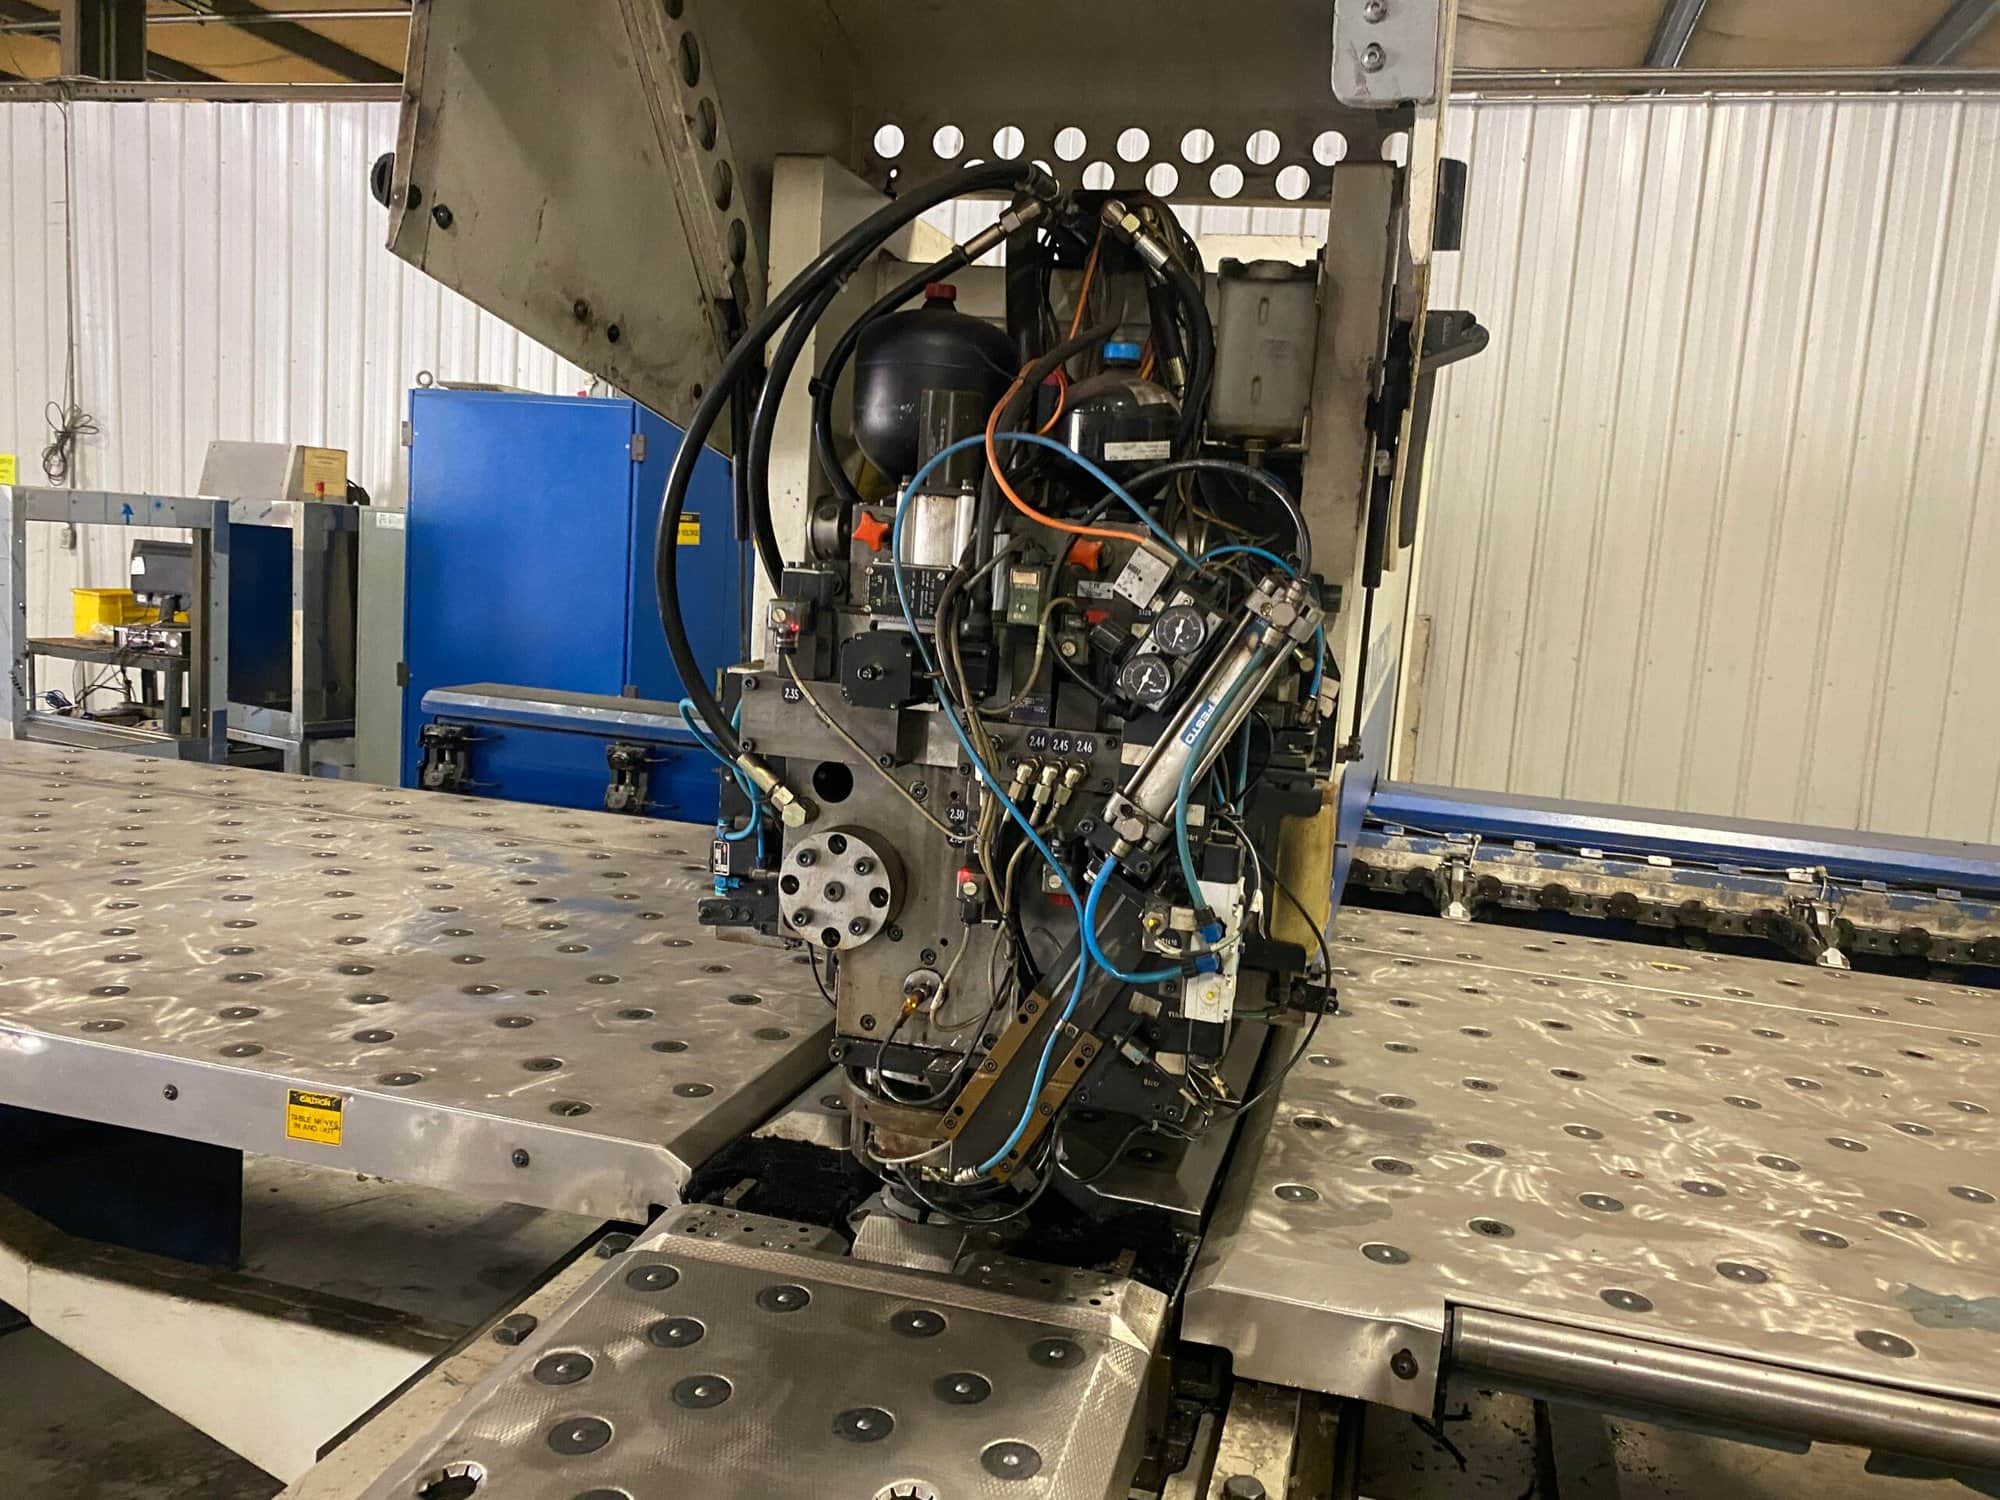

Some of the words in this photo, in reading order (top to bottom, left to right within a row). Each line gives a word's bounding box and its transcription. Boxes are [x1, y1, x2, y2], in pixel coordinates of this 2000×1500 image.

[784, 687, 800, 700] 2.35
[1185, 703, 1216, 745] FESTO
[1029, 735, 1046, 748] 2.44
[1052, 738, 1069, 752] 2.45
[1076, 740, 1093, 753] 2.46
[949, 808, 965, 821] 2.30
[314, 1117, 339, 1129] MVES
